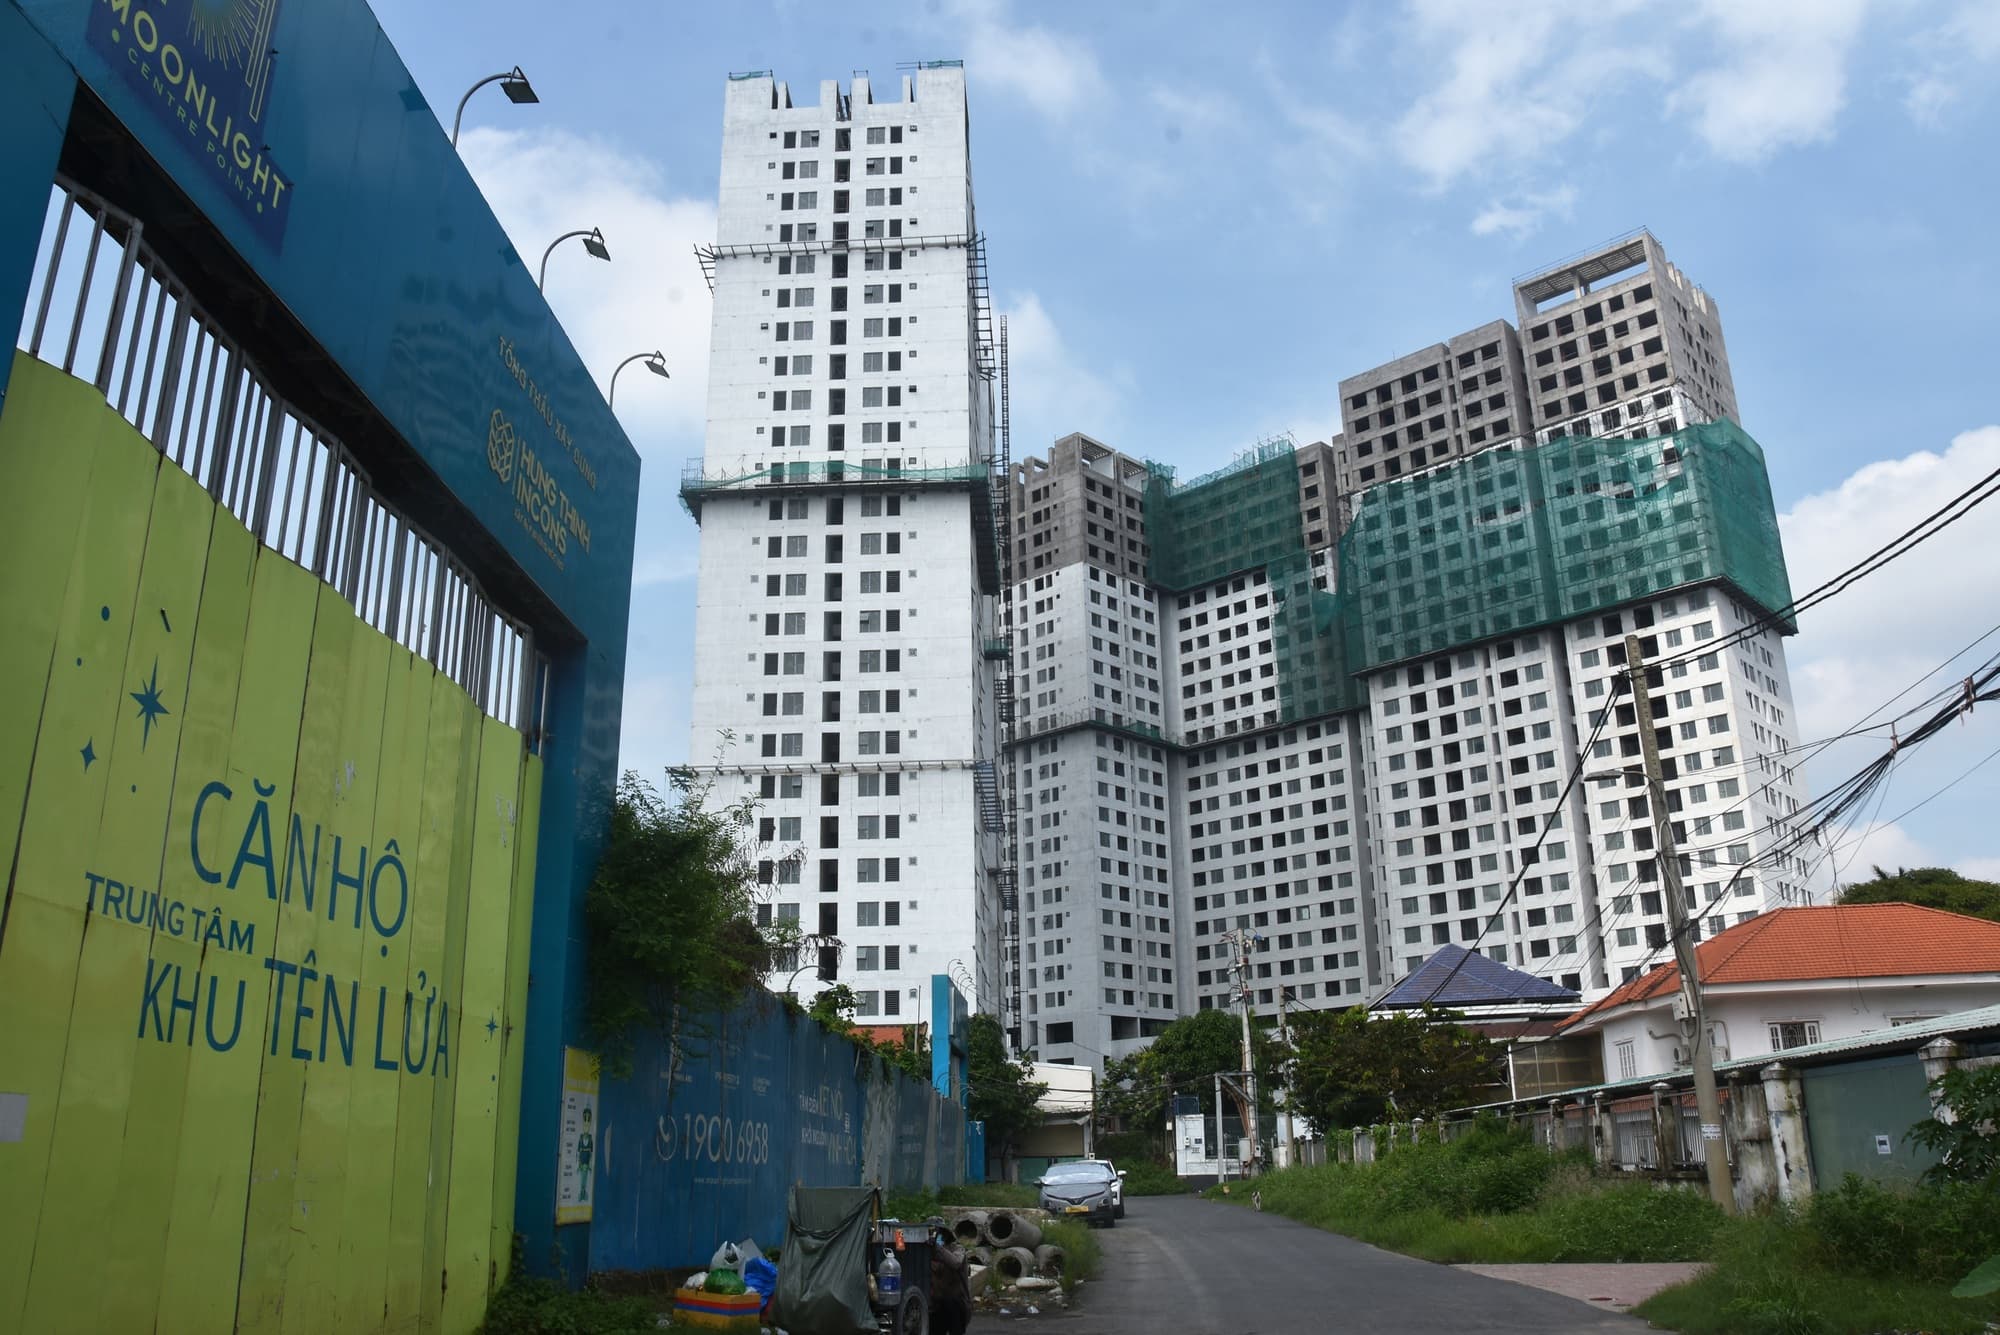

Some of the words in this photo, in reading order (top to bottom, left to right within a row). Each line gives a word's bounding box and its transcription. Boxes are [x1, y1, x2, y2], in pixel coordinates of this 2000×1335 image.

[128, 48, 198, 136] CENTRE
[207, 141, 253, 200] POINT
[517, 473, 567, 555] INCONS
[85, 872, 185, 937] TRUNG
[191, 907, 255, 955] TÂM
[191, 778, 321, 912] CĂN
[328, 836, 408, 958] HỘ
[138, 959, 246, 1053] KHU
[264, 950, 358, 1067] TÊN
[374, 970, 449, 1079] LỬA
[737, 1120, 769, 1166] 6958
